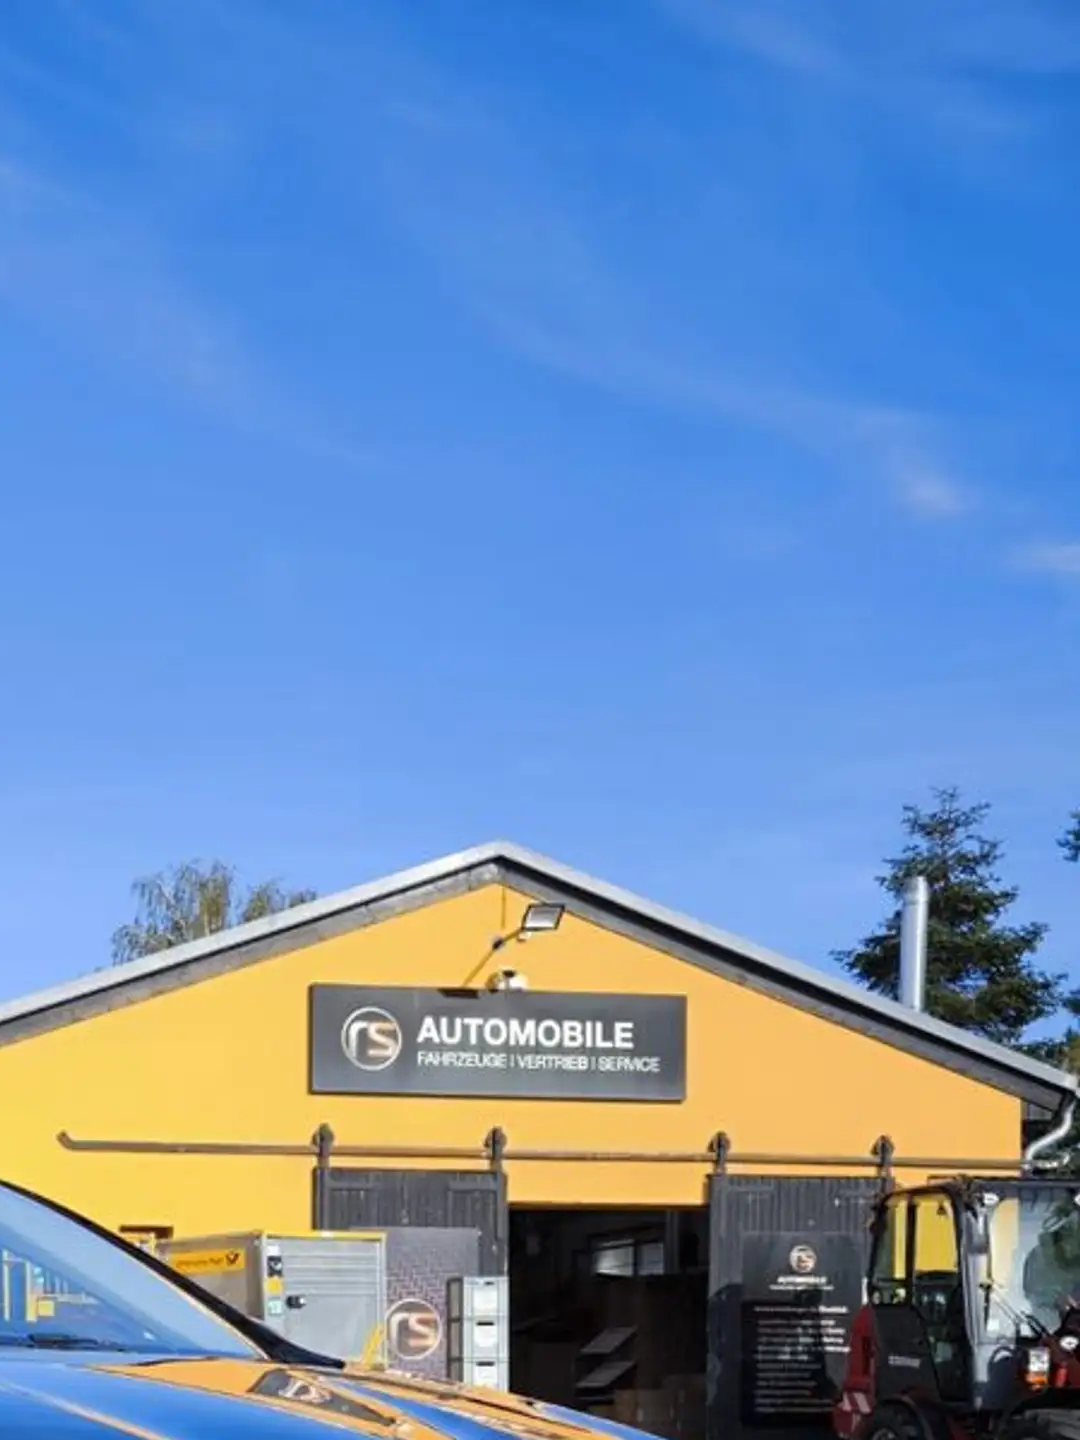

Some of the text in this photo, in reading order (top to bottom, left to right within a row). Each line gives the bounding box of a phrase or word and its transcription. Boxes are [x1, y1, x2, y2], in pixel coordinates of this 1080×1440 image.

[416, 1015, 635, 1049] AUTOMOBILE
[417, 1051, 508, 1069] FAHRZEUGE
[517, 1053, 589, 1071] VERTRIEB
[597, 1056, 661, 1074] SERVICE
